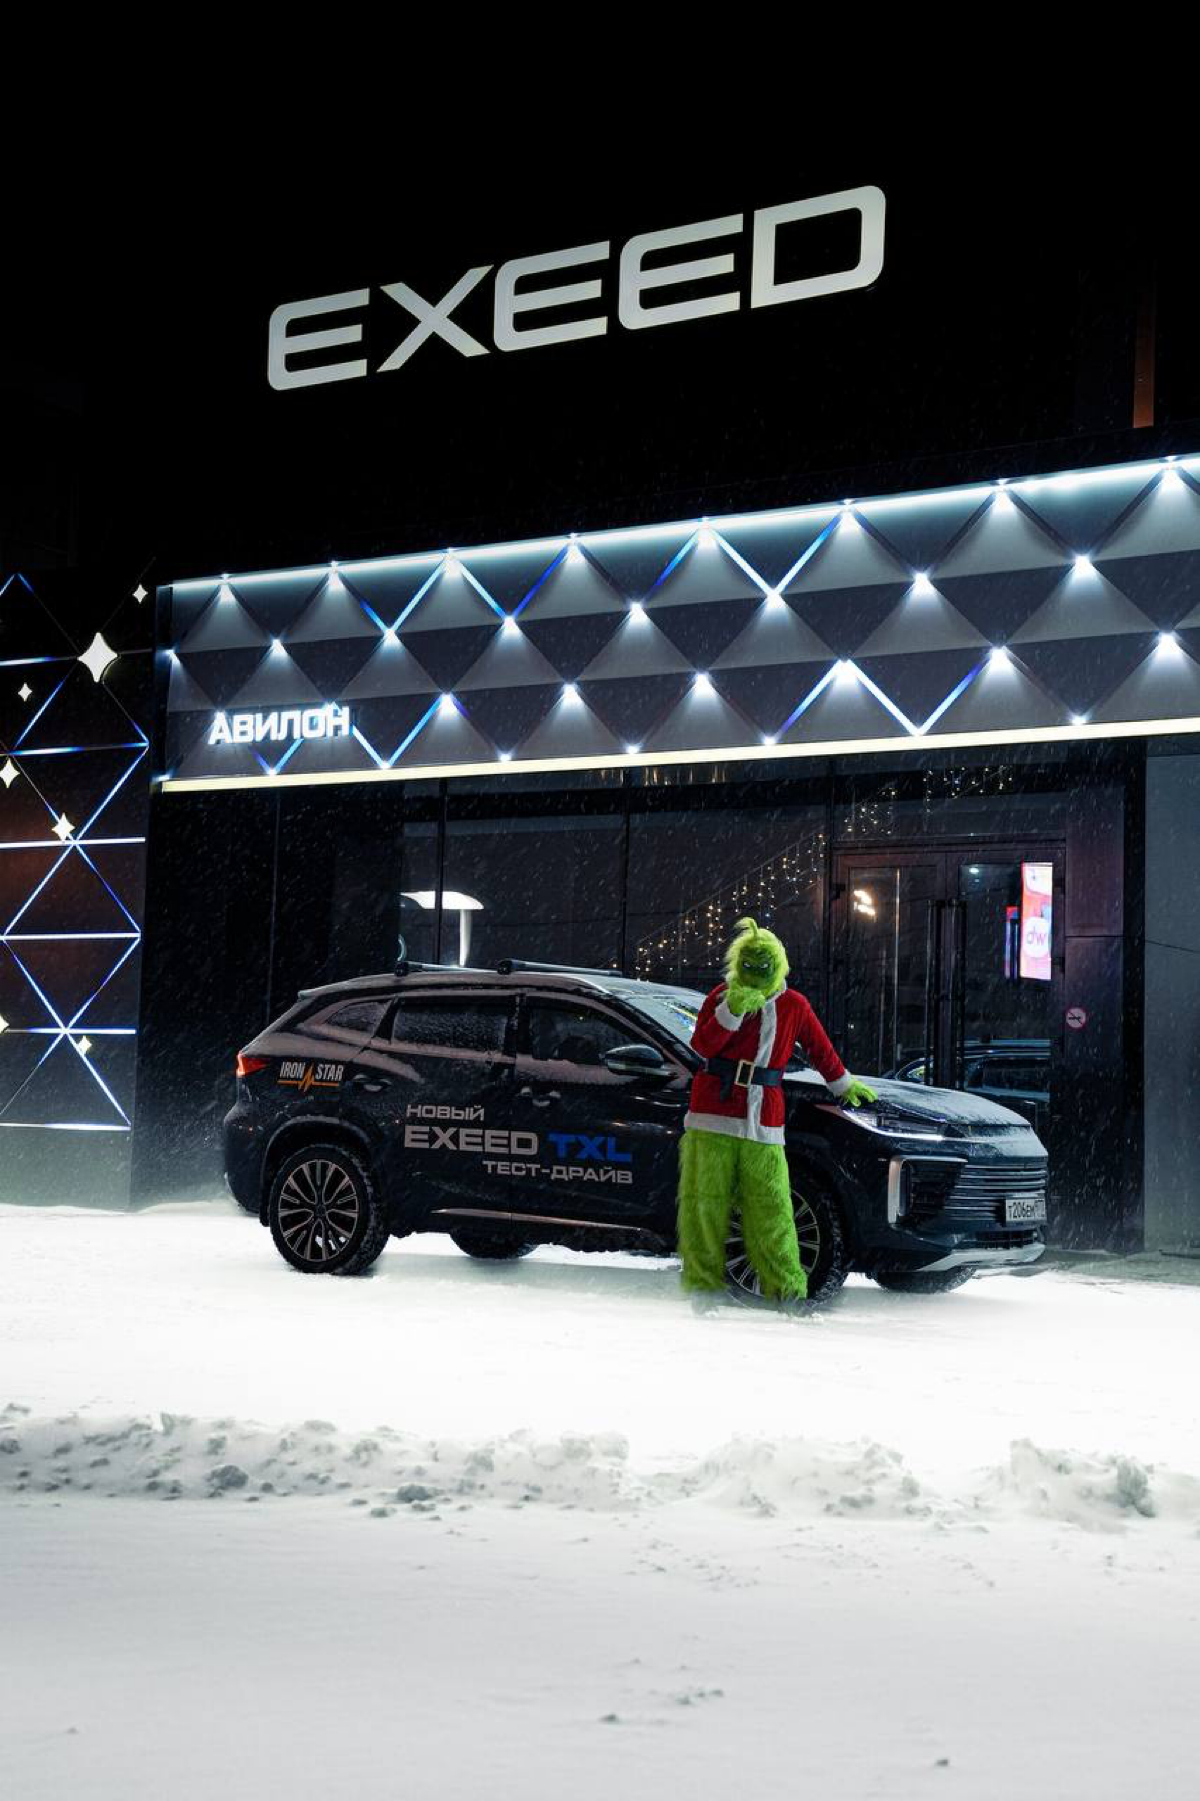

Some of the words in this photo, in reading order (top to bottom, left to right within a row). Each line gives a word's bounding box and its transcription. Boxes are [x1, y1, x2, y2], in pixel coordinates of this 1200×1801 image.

[267, 185, 886, 391] EXEED
[207, 702, 350, 745] АВИЛОН
[280, 1061, 306, 1079] IRON
[315, 1063, 344, 1081] STAR
[406, 1104, 485, 1121] НОВЫЙ
[404, 1125, 538, 1156] EXEED
[547, 1131, 633, 1163] TXL
[482, 1160, 634, 1184] ТЕСТ-ДРАЙВ
